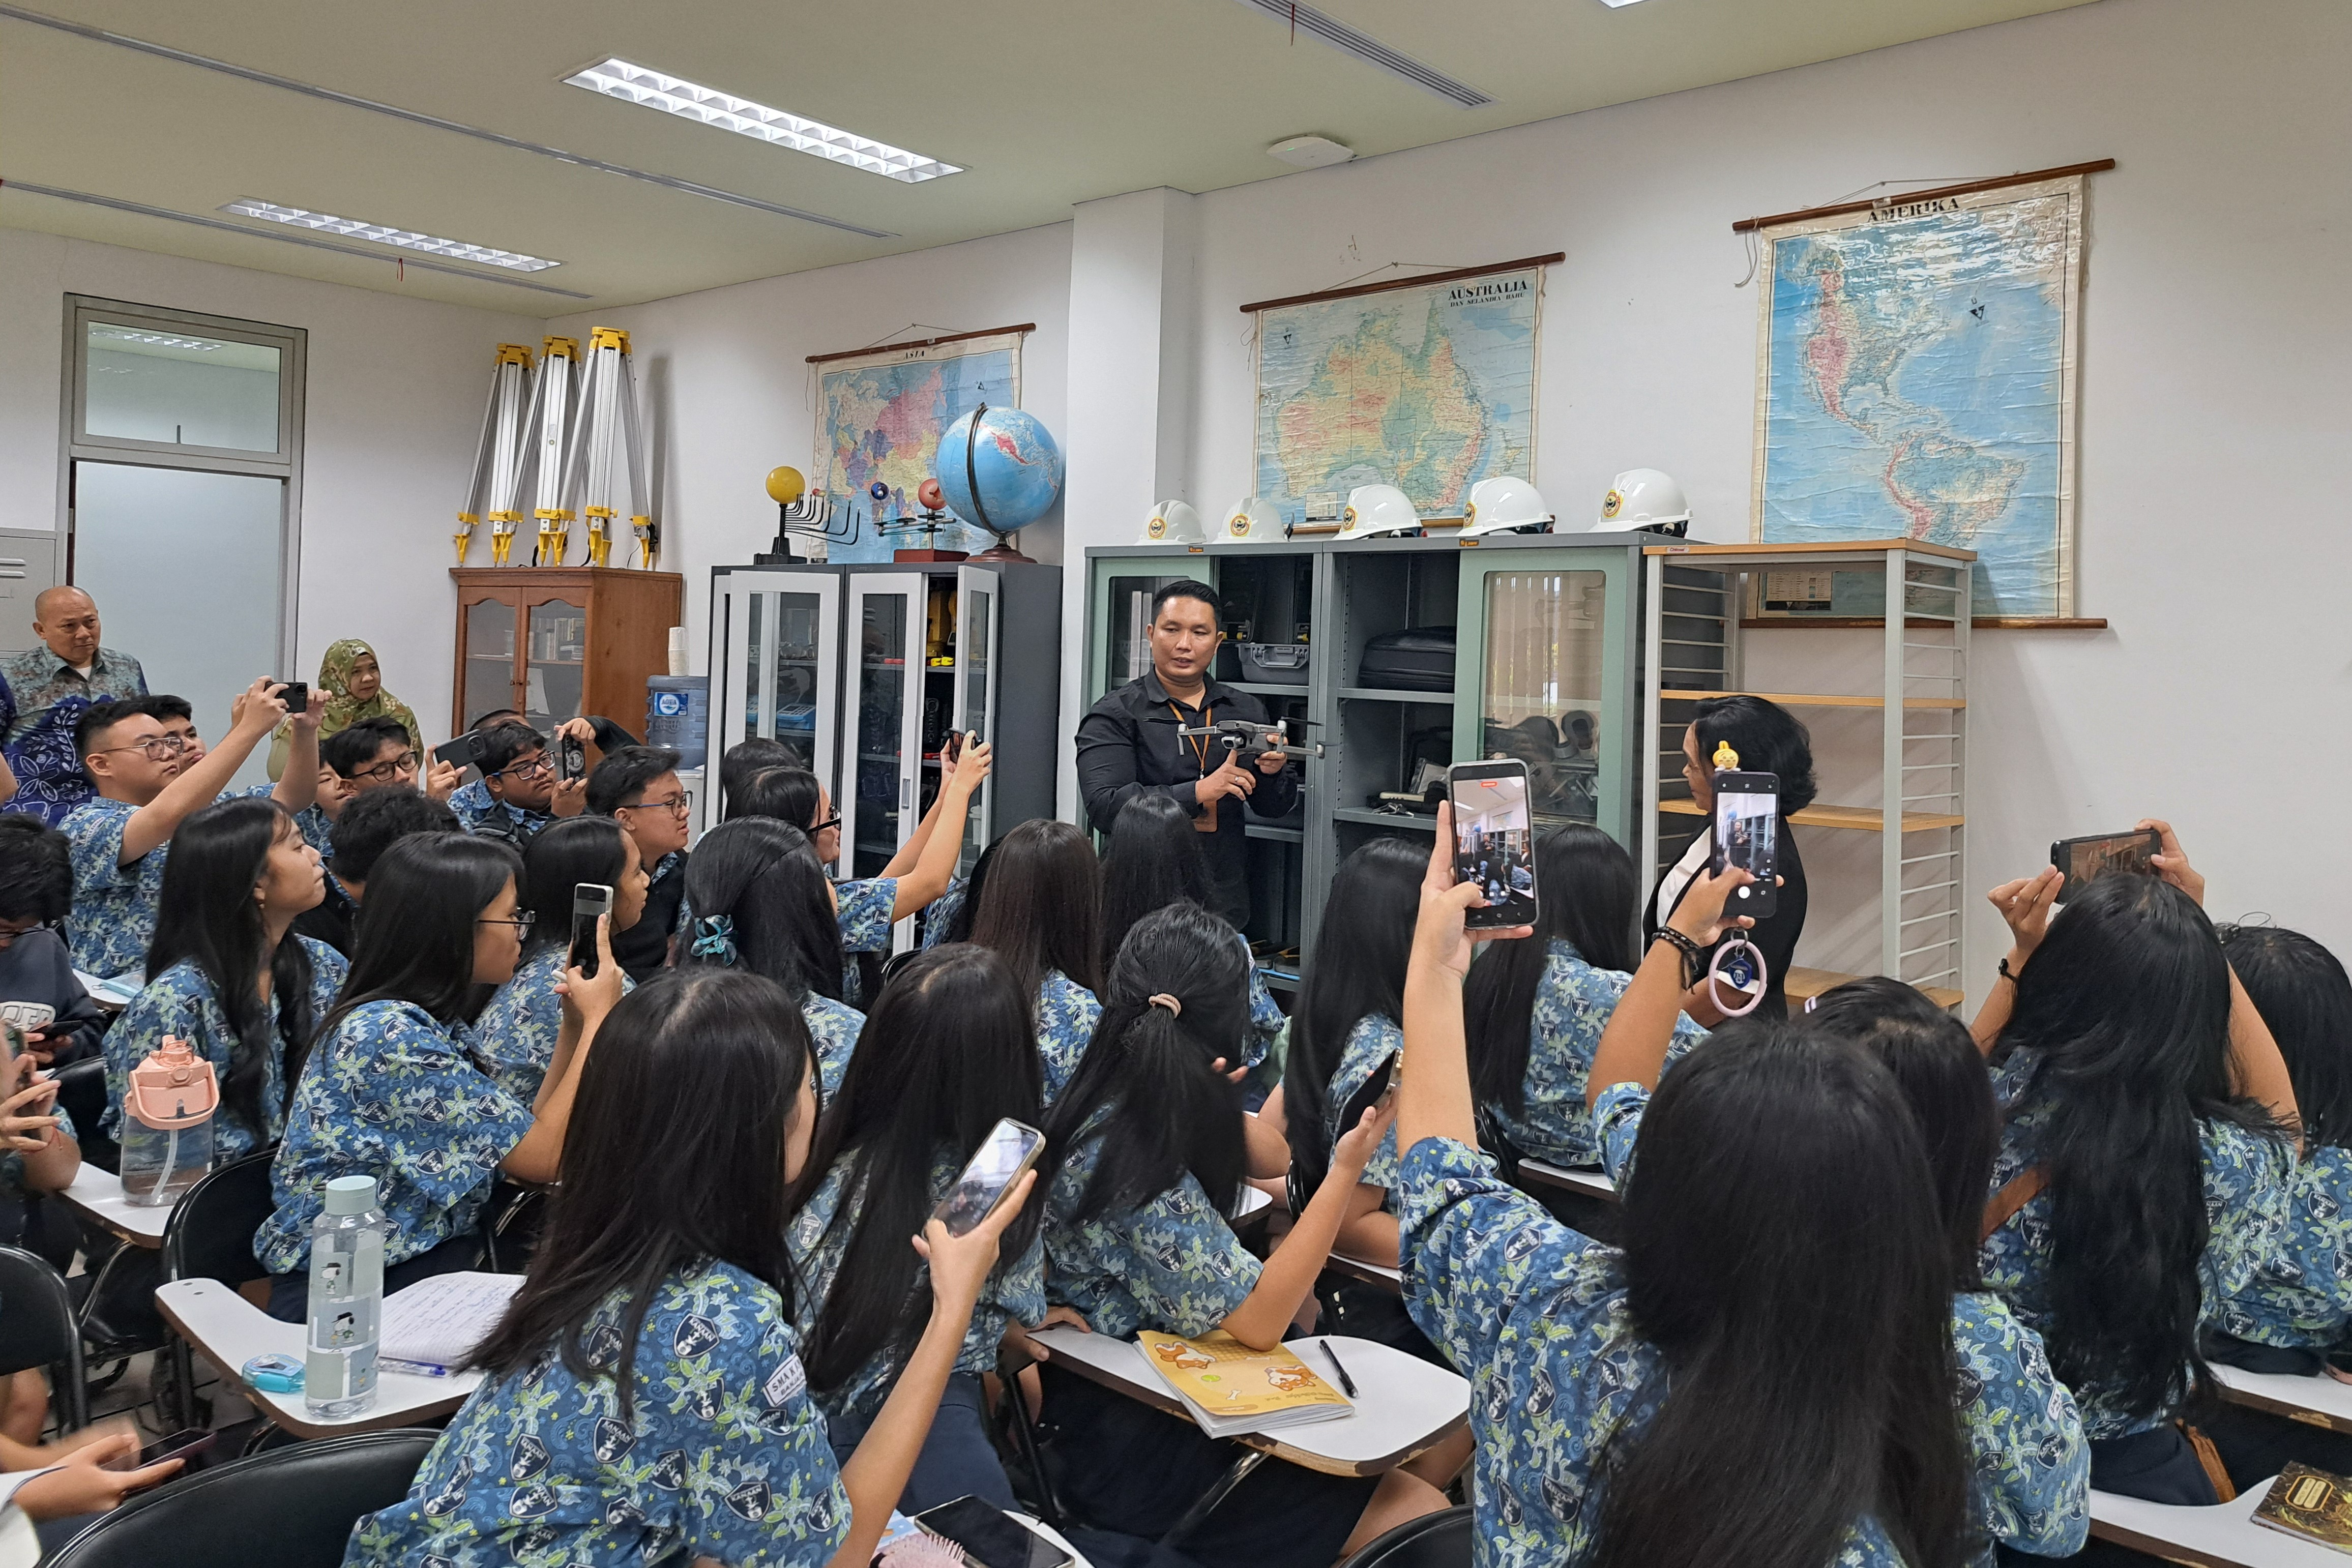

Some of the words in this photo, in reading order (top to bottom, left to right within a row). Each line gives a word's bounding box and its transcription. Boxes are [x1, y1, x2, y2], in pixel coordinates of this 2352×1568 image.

[1868, 198, 1960, 222] AMERIKA
[1448, 280, 1527, 300] AUSTRALIA
[1467, 296, 1502, 305] SELANDIA
[1506, 292, 1525, 300] BARU
[2313, 1194, 2337, 1209] KANAAN
[689, 1317, 715, 1342] KANAAN
[772, 1373, 790, 1393] SMA
[602, 1421, 632, 1443] KANAAN
[520, 1437, 545, 1460] KANAAN
[653, 1451, 680, 1476] KANAAN
[731, 1484, 762, 1501] KANAAN
